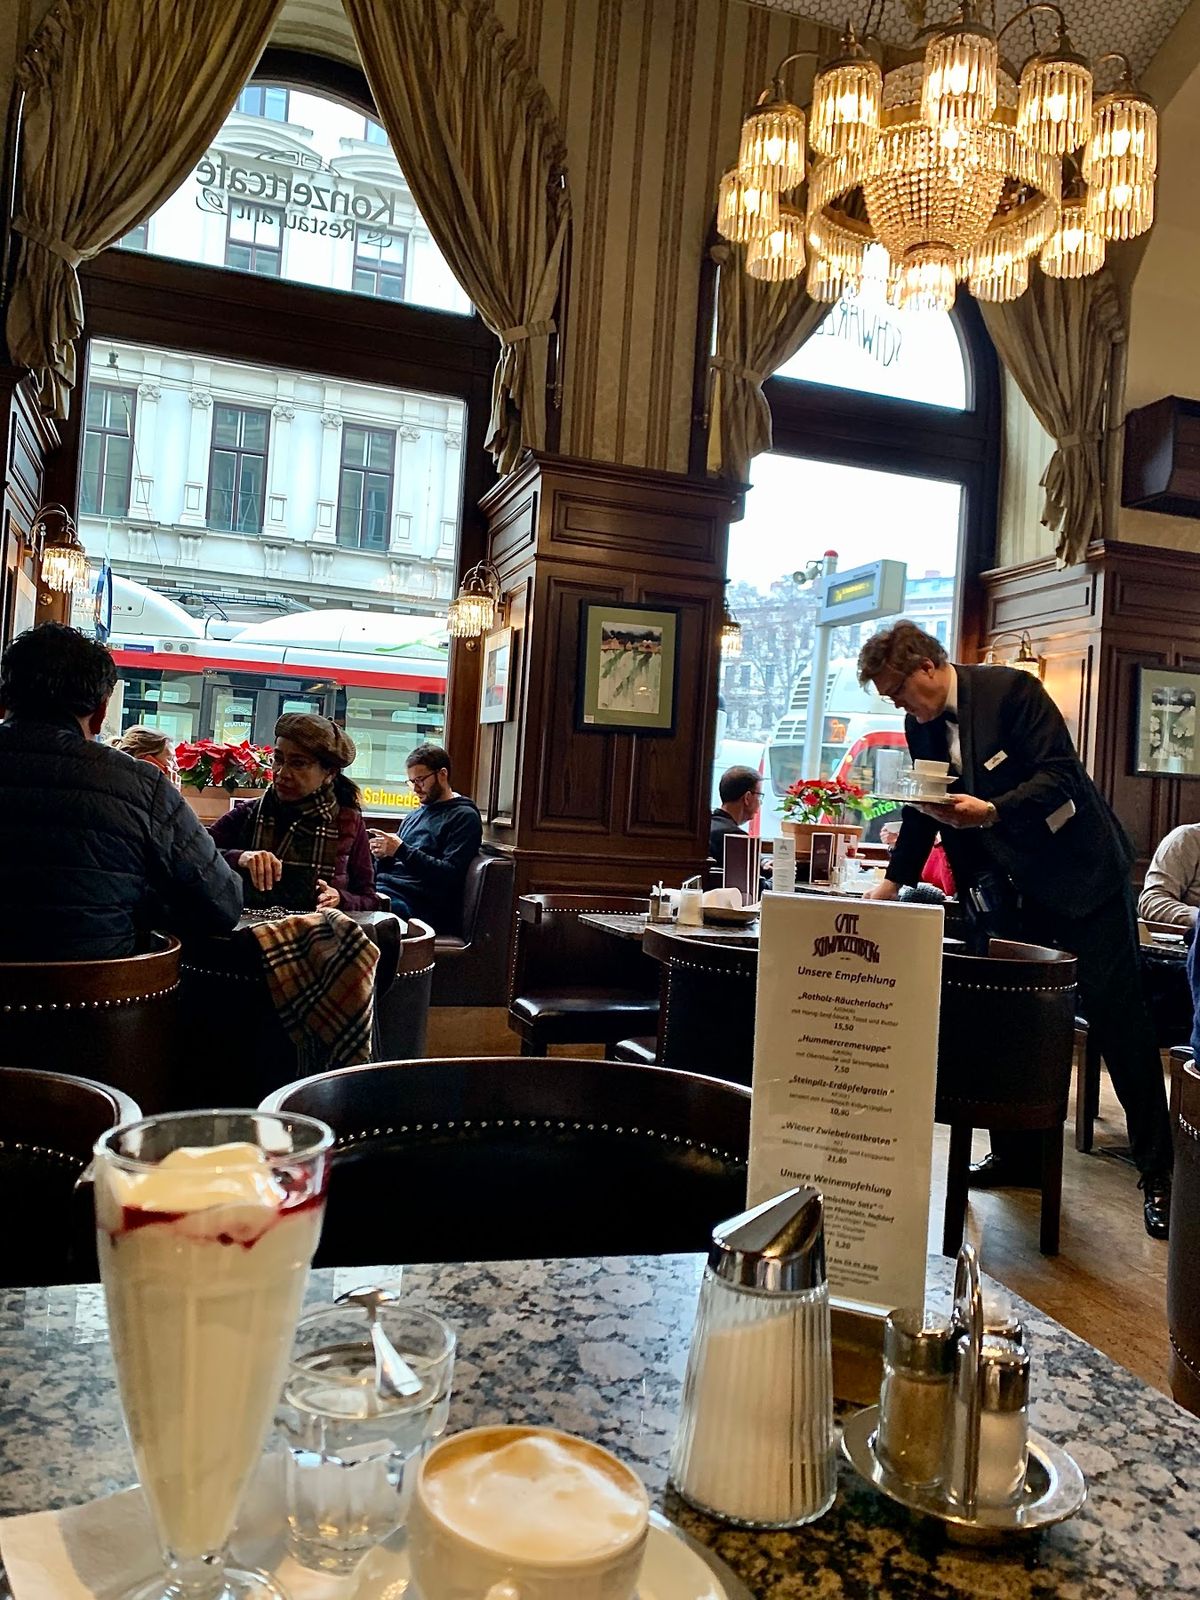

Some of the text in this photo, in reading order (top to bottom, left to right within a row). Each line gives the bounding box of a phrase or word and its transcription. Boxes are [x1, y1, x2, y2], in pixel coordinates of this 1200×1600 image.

[363, 787, 421, 808] Schuede
[797, 966, 896, 988] Unsere Empfehlung
[834, 1022, 854, 1031] 15,50
[834, 1064, 850, 1074] 7,50
[780, 1168, 892, 1197] Unsere Weinempfehlung
[823, 1195, 856, 1206] mischter
